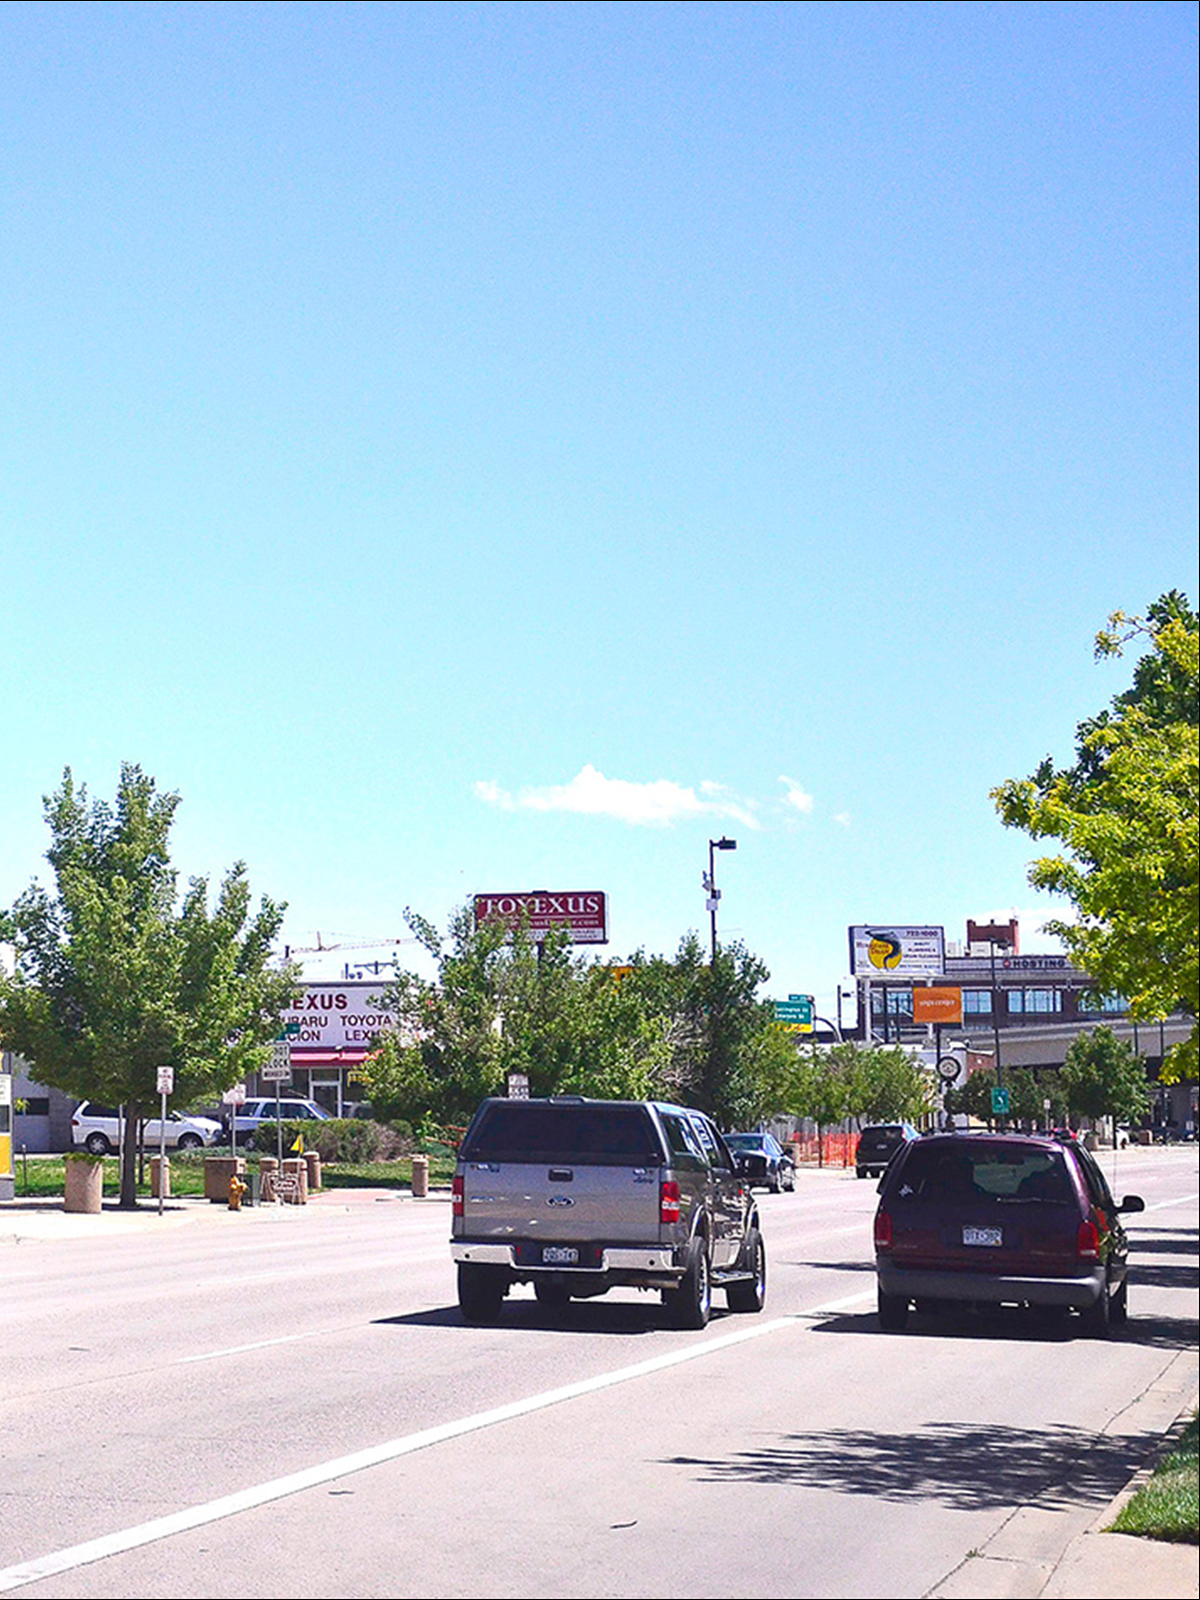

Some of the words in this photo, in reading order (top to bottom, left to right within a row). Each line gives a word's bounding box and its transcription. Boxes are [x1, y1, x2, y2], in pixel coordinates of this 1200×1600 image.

[481, 896, 599, 914] TOYEXUS
[1013, 959, 1065, 969] HOSTING
[292, 993, 348, 1010] EXUS
[340, 1014, 393, 1027] TOYOTA
